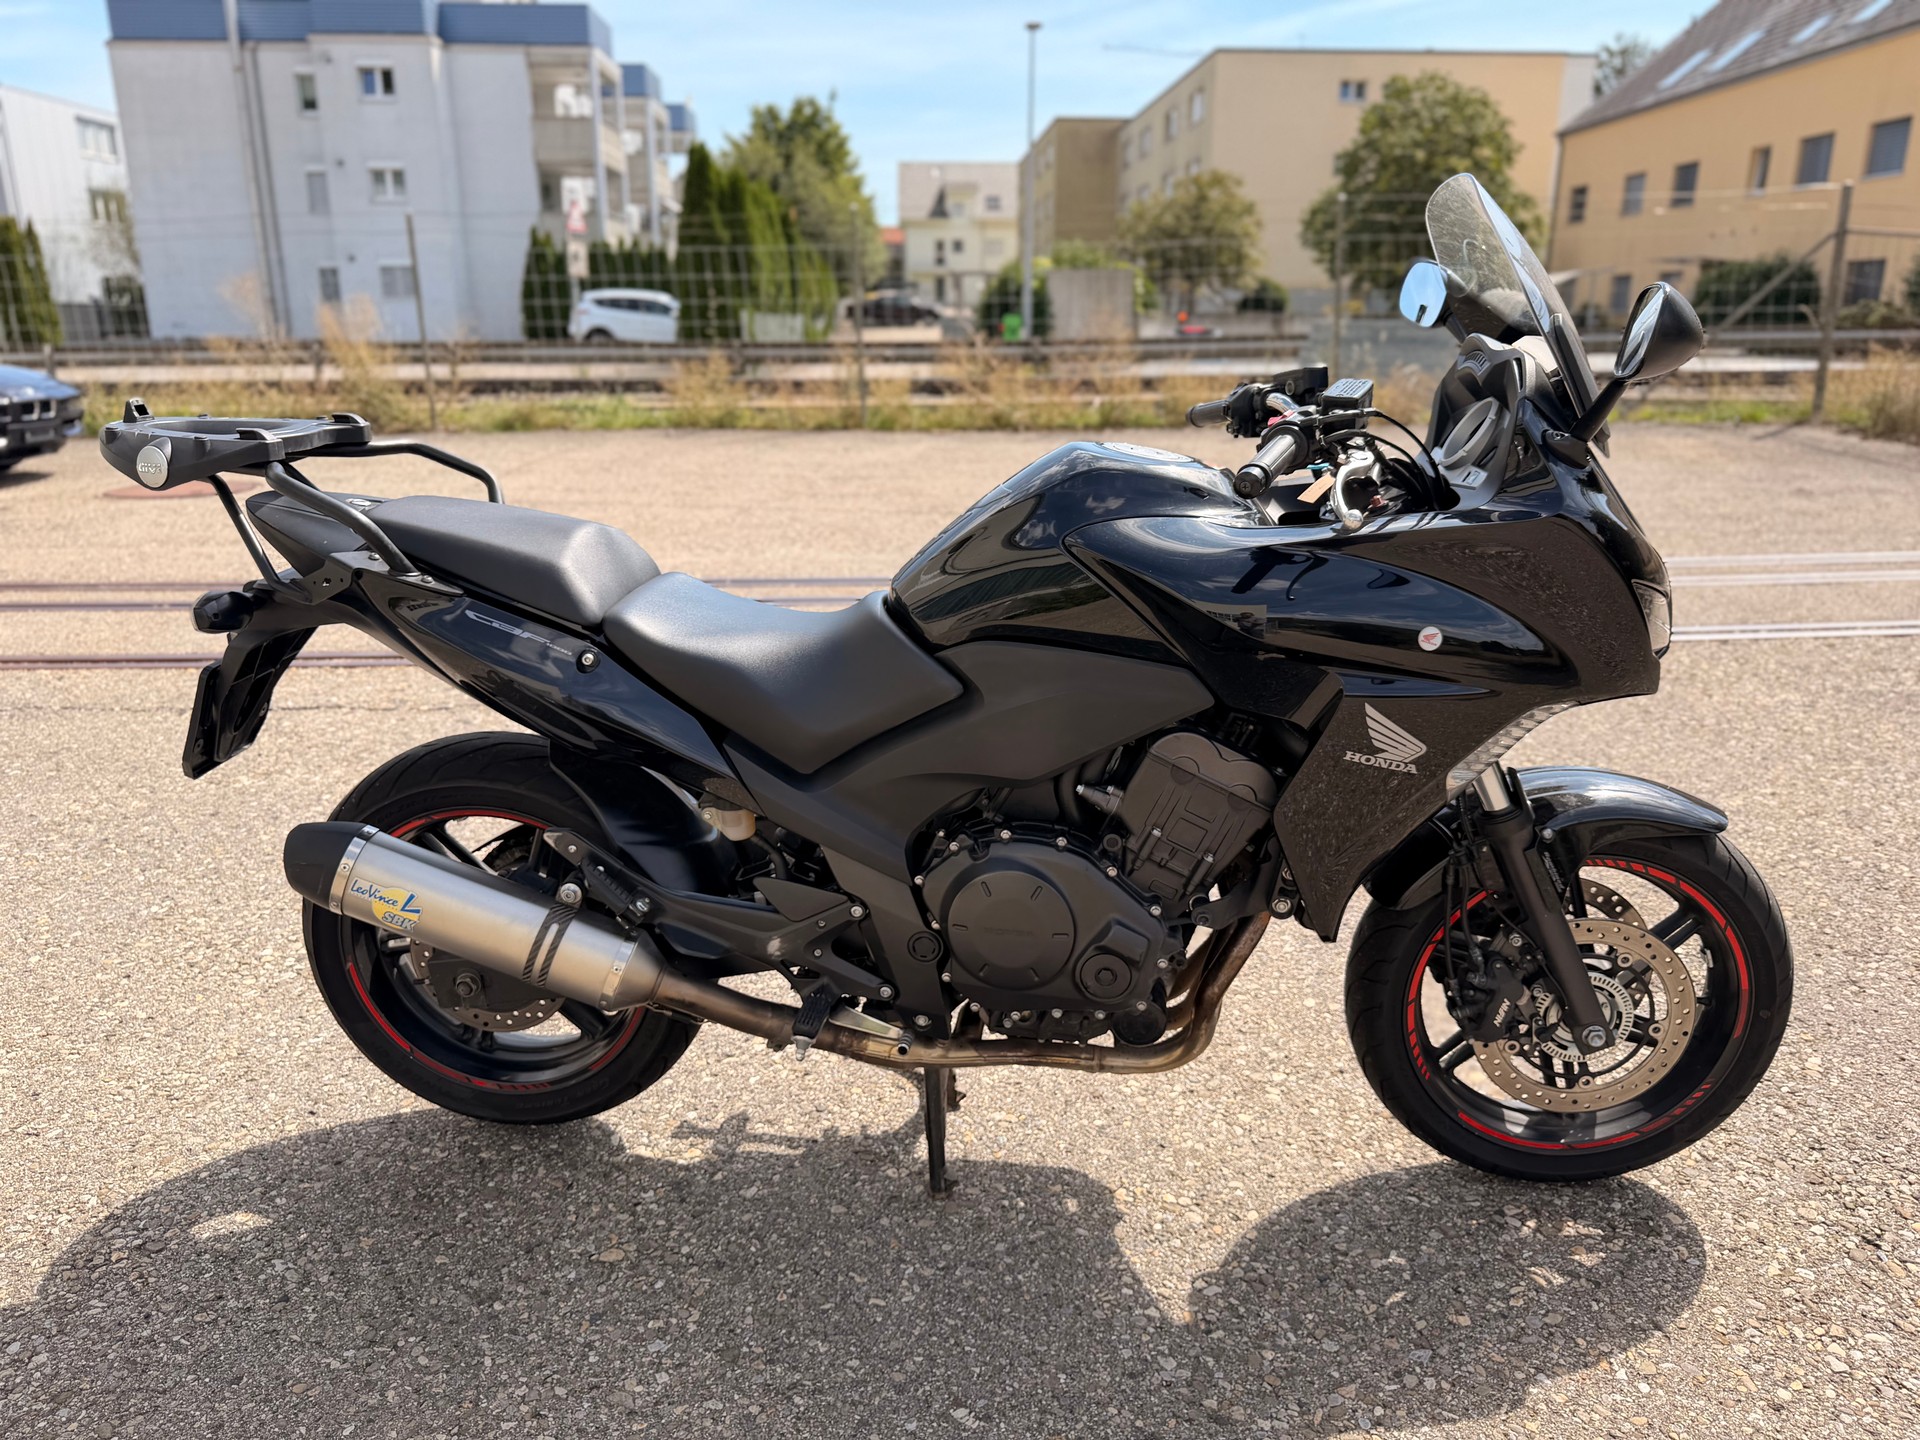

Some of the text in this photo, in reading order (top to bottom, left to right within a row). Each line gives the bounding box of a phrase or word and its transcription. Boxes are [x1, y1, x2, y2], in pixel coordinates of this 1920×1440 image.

[1343, 751, 1418, 774] HONDA
[350, 879, 398, 907] LeoVince
[381, 911, 419, 931] SBK
